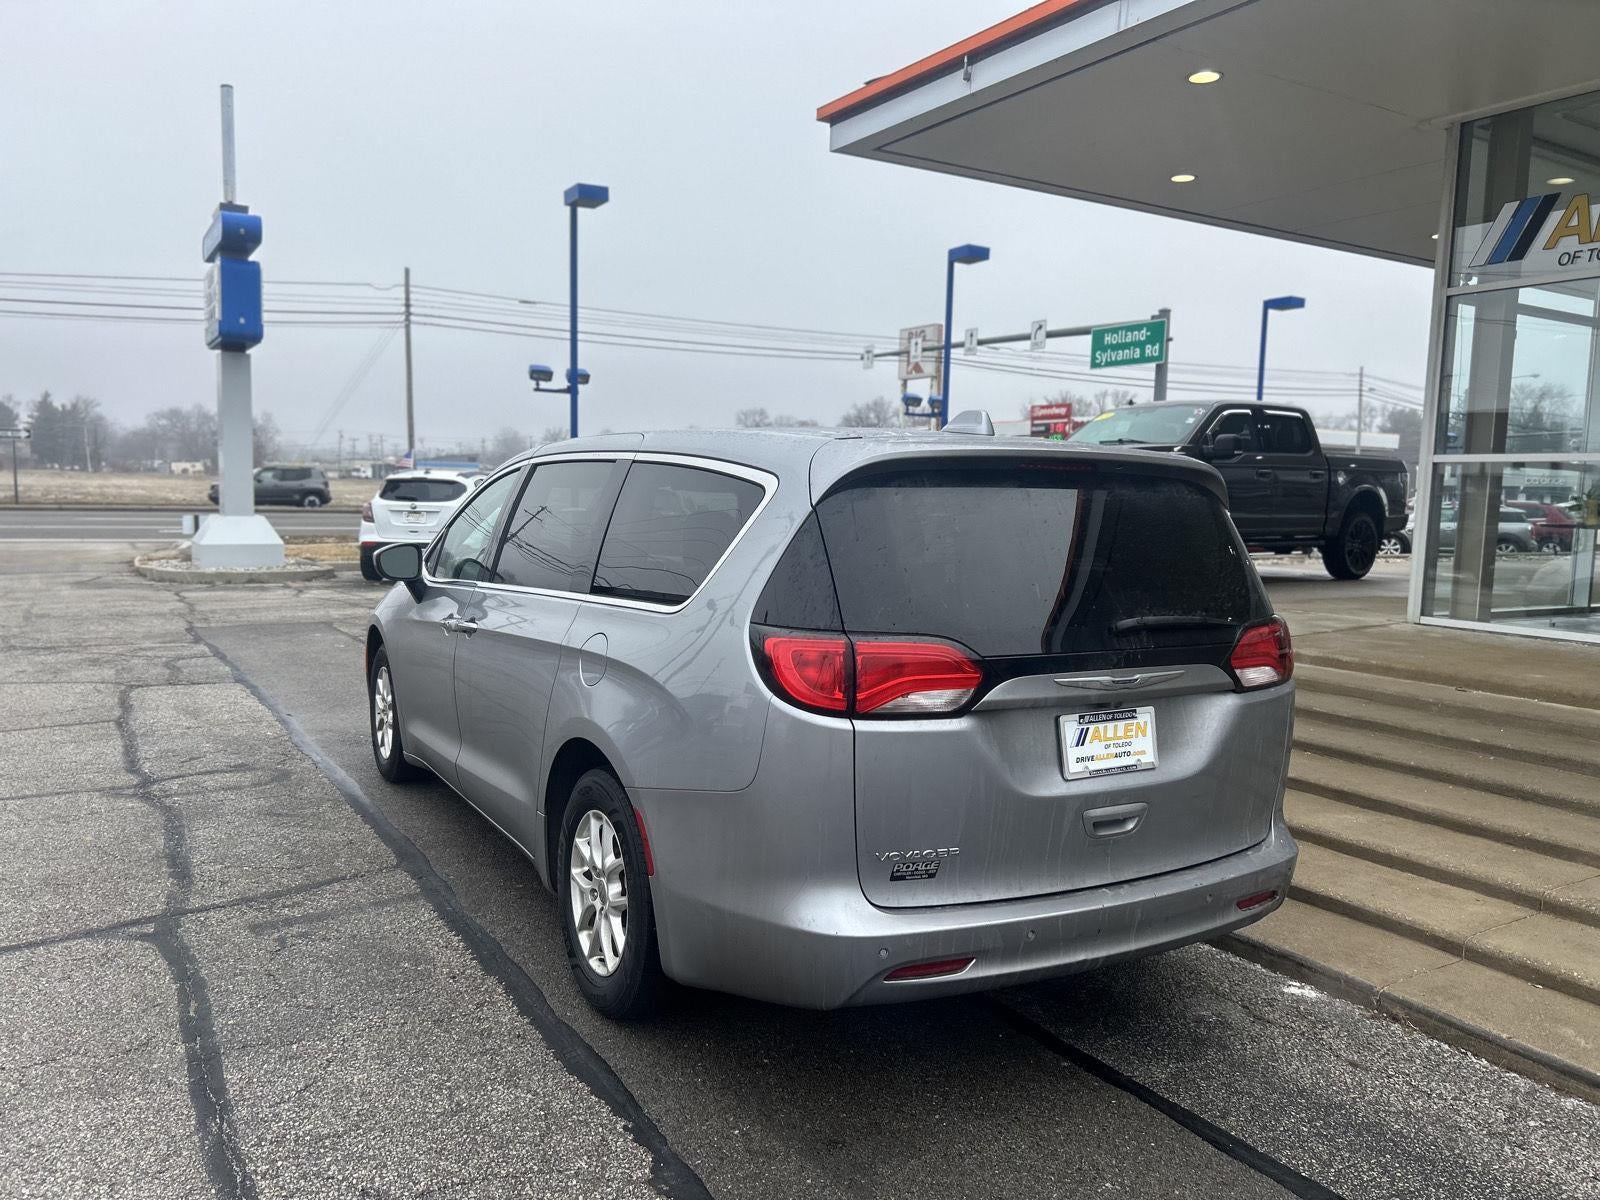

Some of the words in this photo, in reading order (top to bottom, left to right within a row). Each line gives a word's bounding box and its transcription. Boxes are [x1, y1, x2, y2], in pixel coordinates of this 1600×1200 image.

[1542, 193, 1600, 250] A
[1557, 250, 1582, 267] OF
[1104, 327, 1151, 345] Holland-
[1095, 346, 1140, 365] Sylvania
[1145, 343, 1159, 357] Rd
[1089, 713, 1106, 722] ALLEN
[1106, 712, 1113, 720] OF
[1114, 711, 1132, 719] TOLEDO
[1089, 721, 1148, 743] ALLEN
[1112, 741, 1132, 749] TOLEDO
[875, 847, 960, 862] VOYAGER
[893, 861, 940, 872] POAGE
